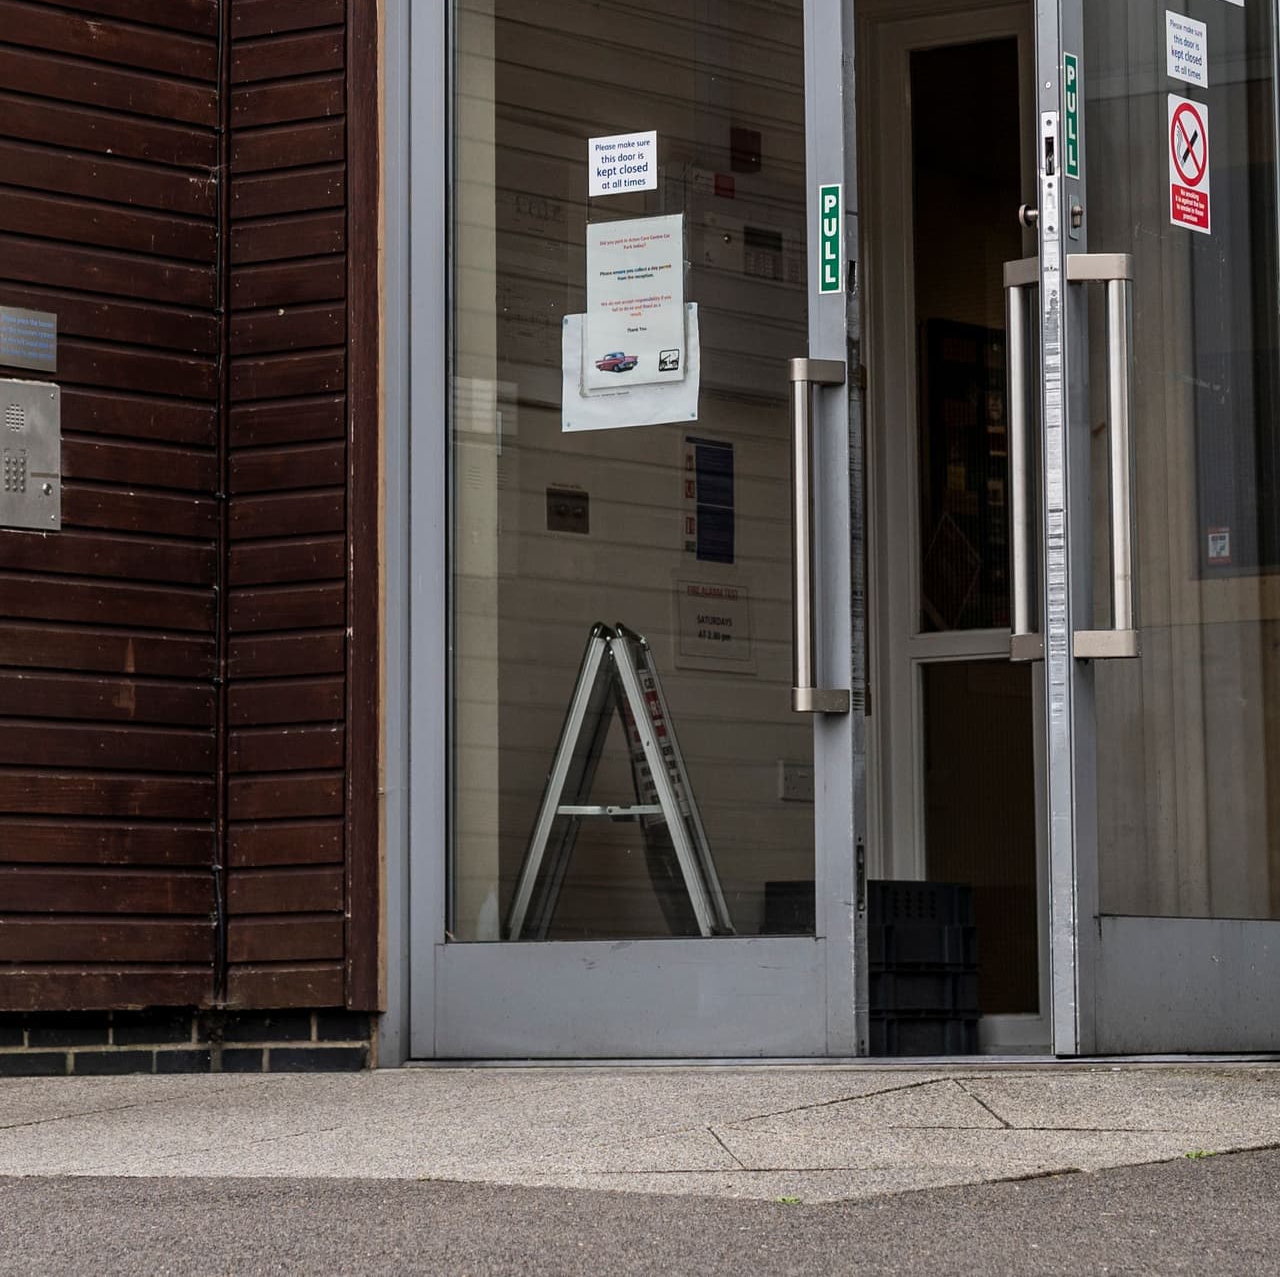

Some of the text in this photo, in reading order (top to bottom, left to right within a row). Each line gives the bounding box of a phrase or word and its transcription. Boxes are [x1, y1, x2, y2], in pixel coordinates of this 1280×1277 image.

[1174, 34, 1183, 45] this
[1184, 37, 1195, 50] door
[1171, 45, 1202, 66] kept closed
[1188, 68, 1201, 80] times
[1067, 65, 1076, 167] PULL
[595, 144, 616, 152] Please
[618, 141, 636, 149] make
[602, 152, 645, 164] this door is
[597, 162, 649, 178] kept closed
[602, 178, 646, 190] at all times
[824, 195, 837, 283] PULL
[697, 614, 732, 627] SATURDAYS
